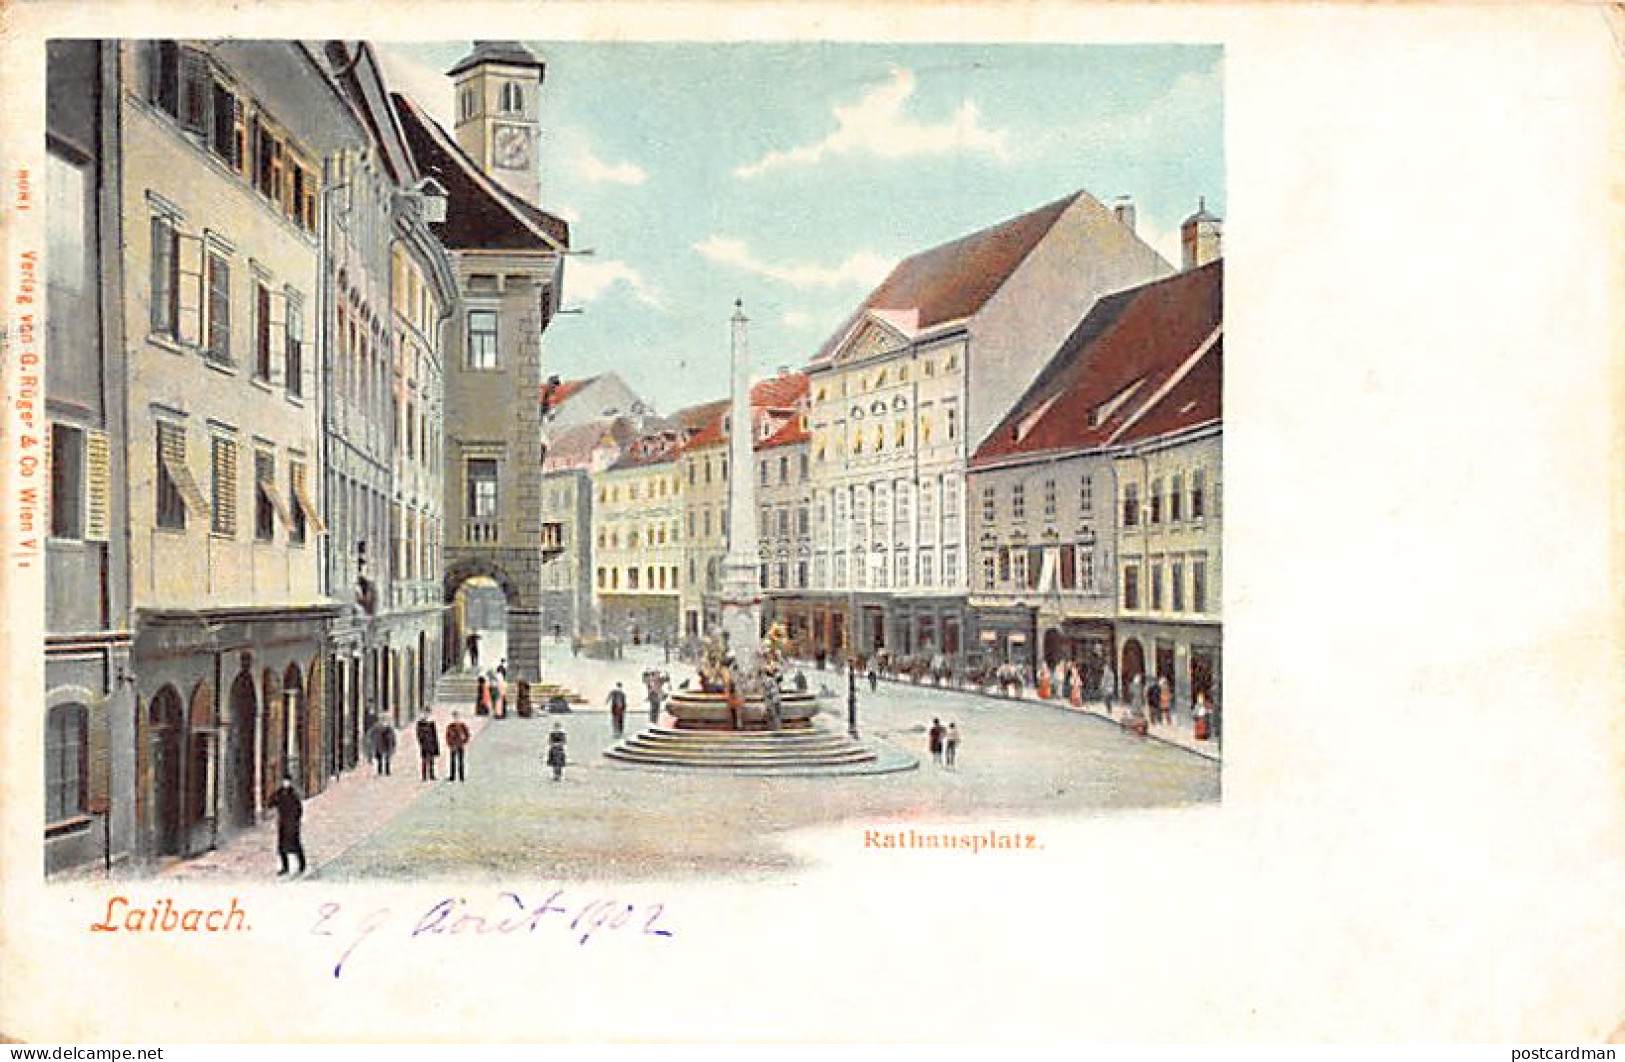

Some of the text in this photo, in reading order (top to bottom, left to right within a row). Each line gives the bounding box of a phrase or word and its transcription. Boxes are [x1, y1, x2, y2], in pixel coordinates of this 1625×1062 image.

[16, 251, 38, 306] Verlag
[20, 315, 34, 343] von
[21, 435, 38, 450] &
[20, 488, 38, 532] Wien
[864, 829, 1046, 854] Rathausplatz.
[90, 896, 252, 932] Laibach.
[570, 899, 674, 946] 1902
